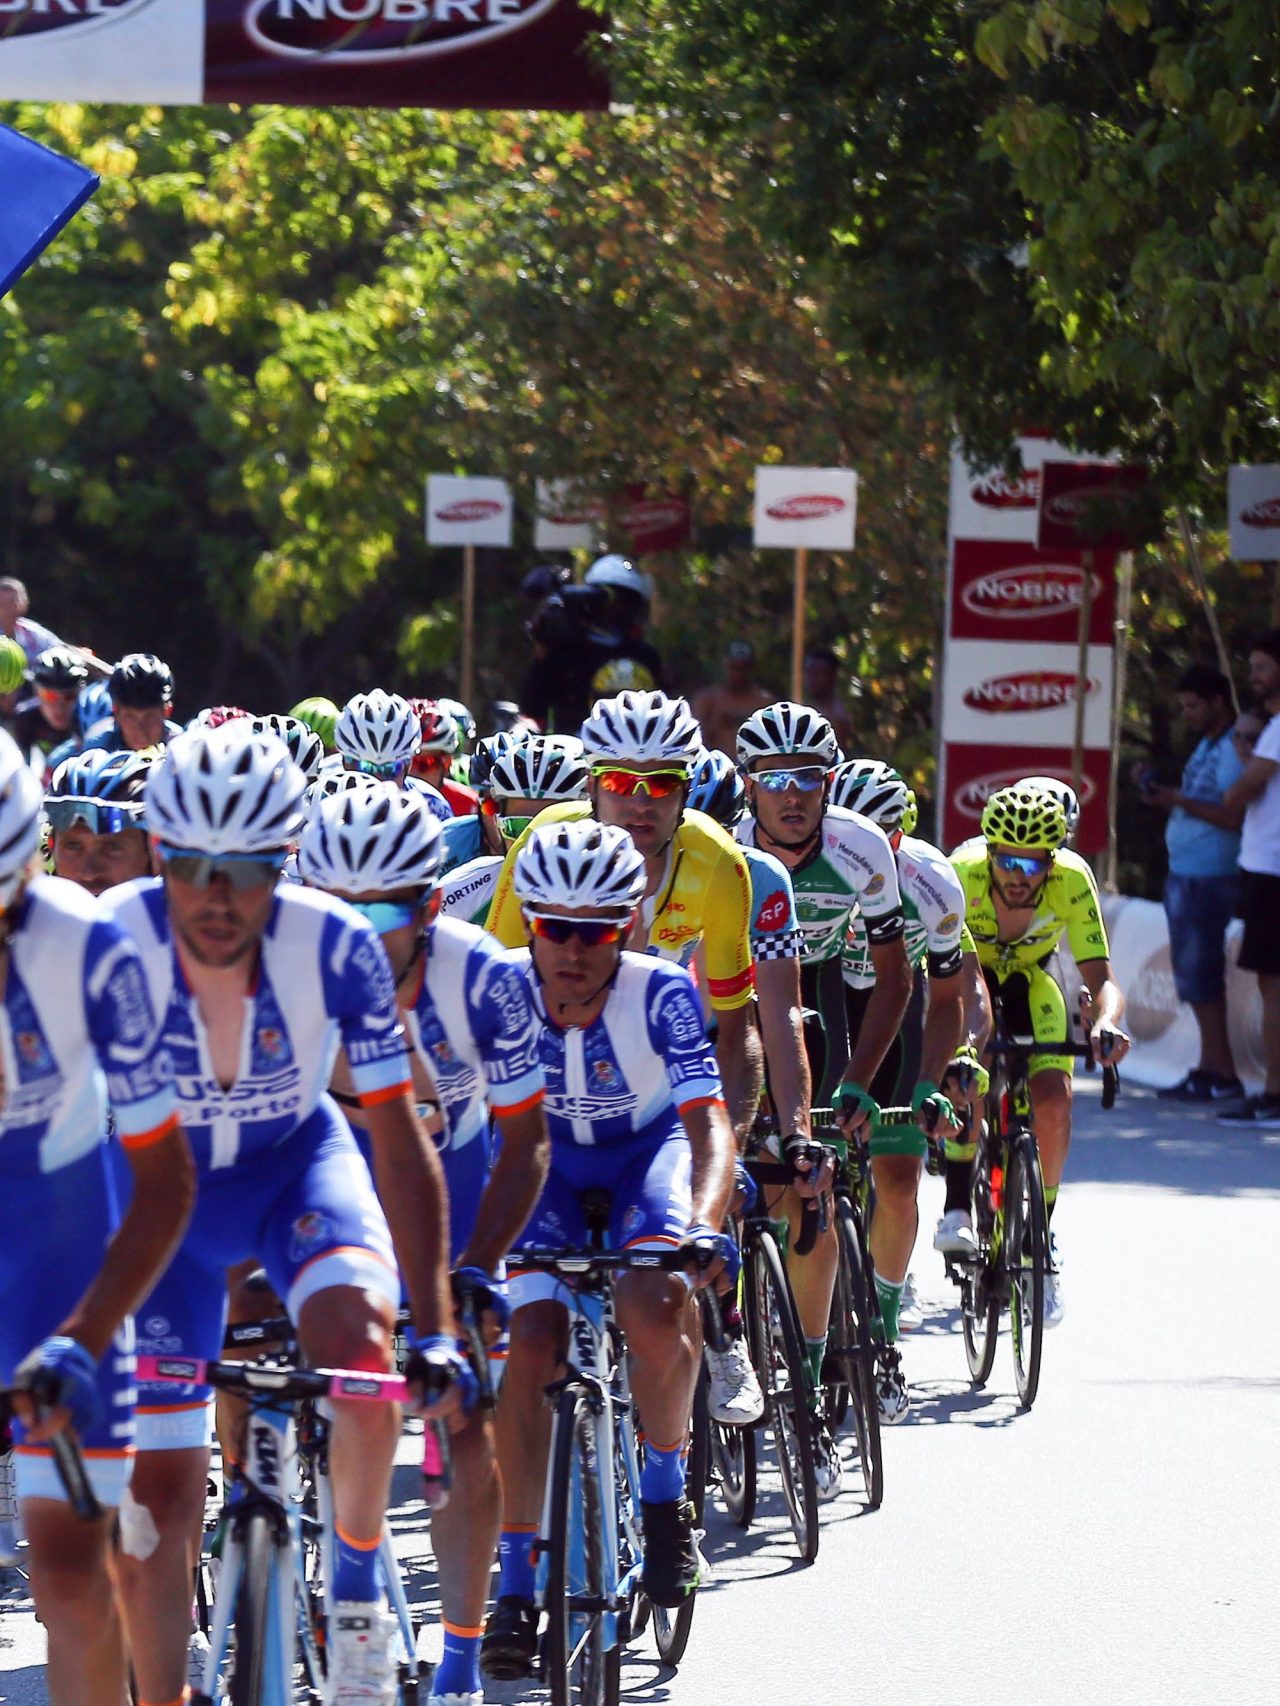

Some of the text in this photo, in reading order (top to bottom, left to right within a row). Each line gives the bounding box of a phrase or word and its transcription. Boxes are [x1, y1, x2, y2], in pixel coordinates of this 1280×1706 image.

[976, 578, 1083, 604] NOBRE
[440, 874, 492, 914] PORTING
[201, 1096, 301, 1121] Porto
